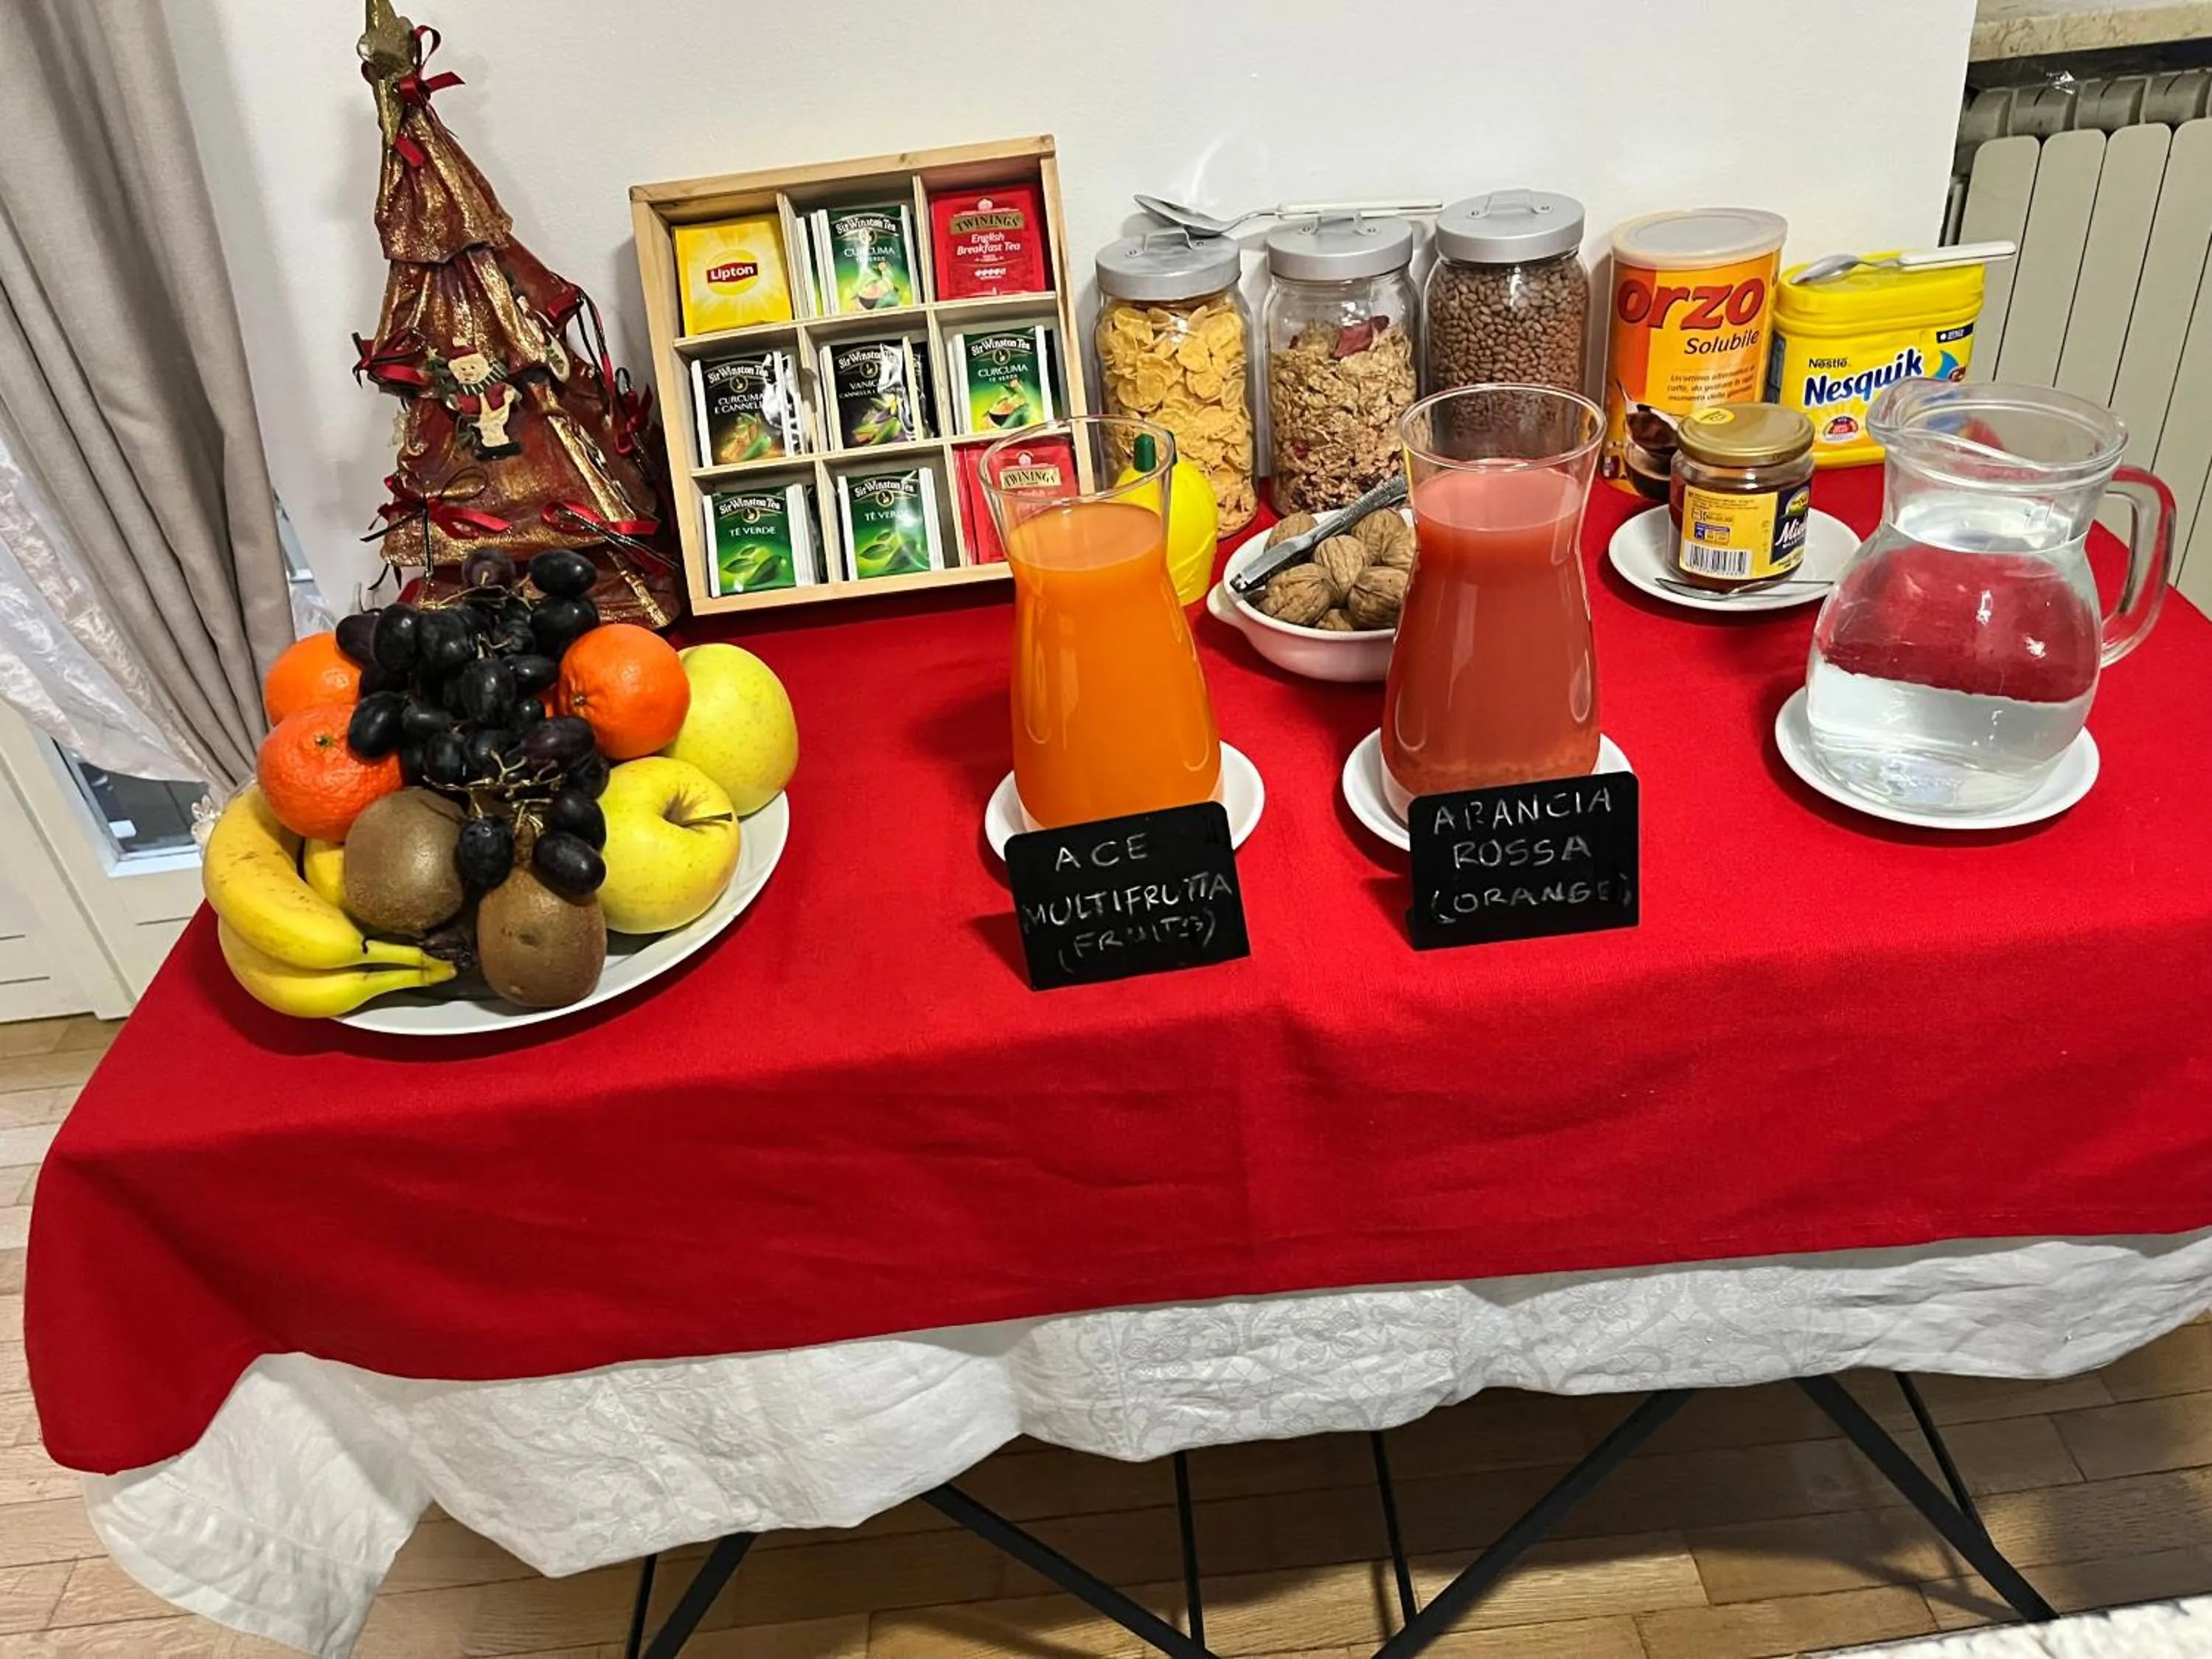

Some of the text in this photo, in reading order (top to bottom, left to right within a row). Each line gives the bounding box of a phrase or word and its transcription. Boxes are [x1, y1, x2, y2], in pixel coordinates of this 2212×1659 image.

[847, 218, 883, 229] Winston
[956, 214, 1020, 232] TWININGS
[971, 232, 1004, 244] English
[957, 242, 1020, 256] Breakfast Tea
[710, 265, 754, 280] Lipton
[1617, 278, 1765, 330] orzo
[981, 338, 1017, 350] Winston
[1684, 330, 1759, 354] Solubile
[849, 351, 882, 362] Winsto
[719, 366, 754, 378] Winston
[978, 364, 1029, 378] CURCUMA
[1804, 348, 1922, 406] Nesquik
[865, 480, 900, 492] Winston
[730, 498, 766, 509] Winston
[1433, 786, 1613, 835] ARANCIA
[1453, 834, 1593, 870] ROSSA
